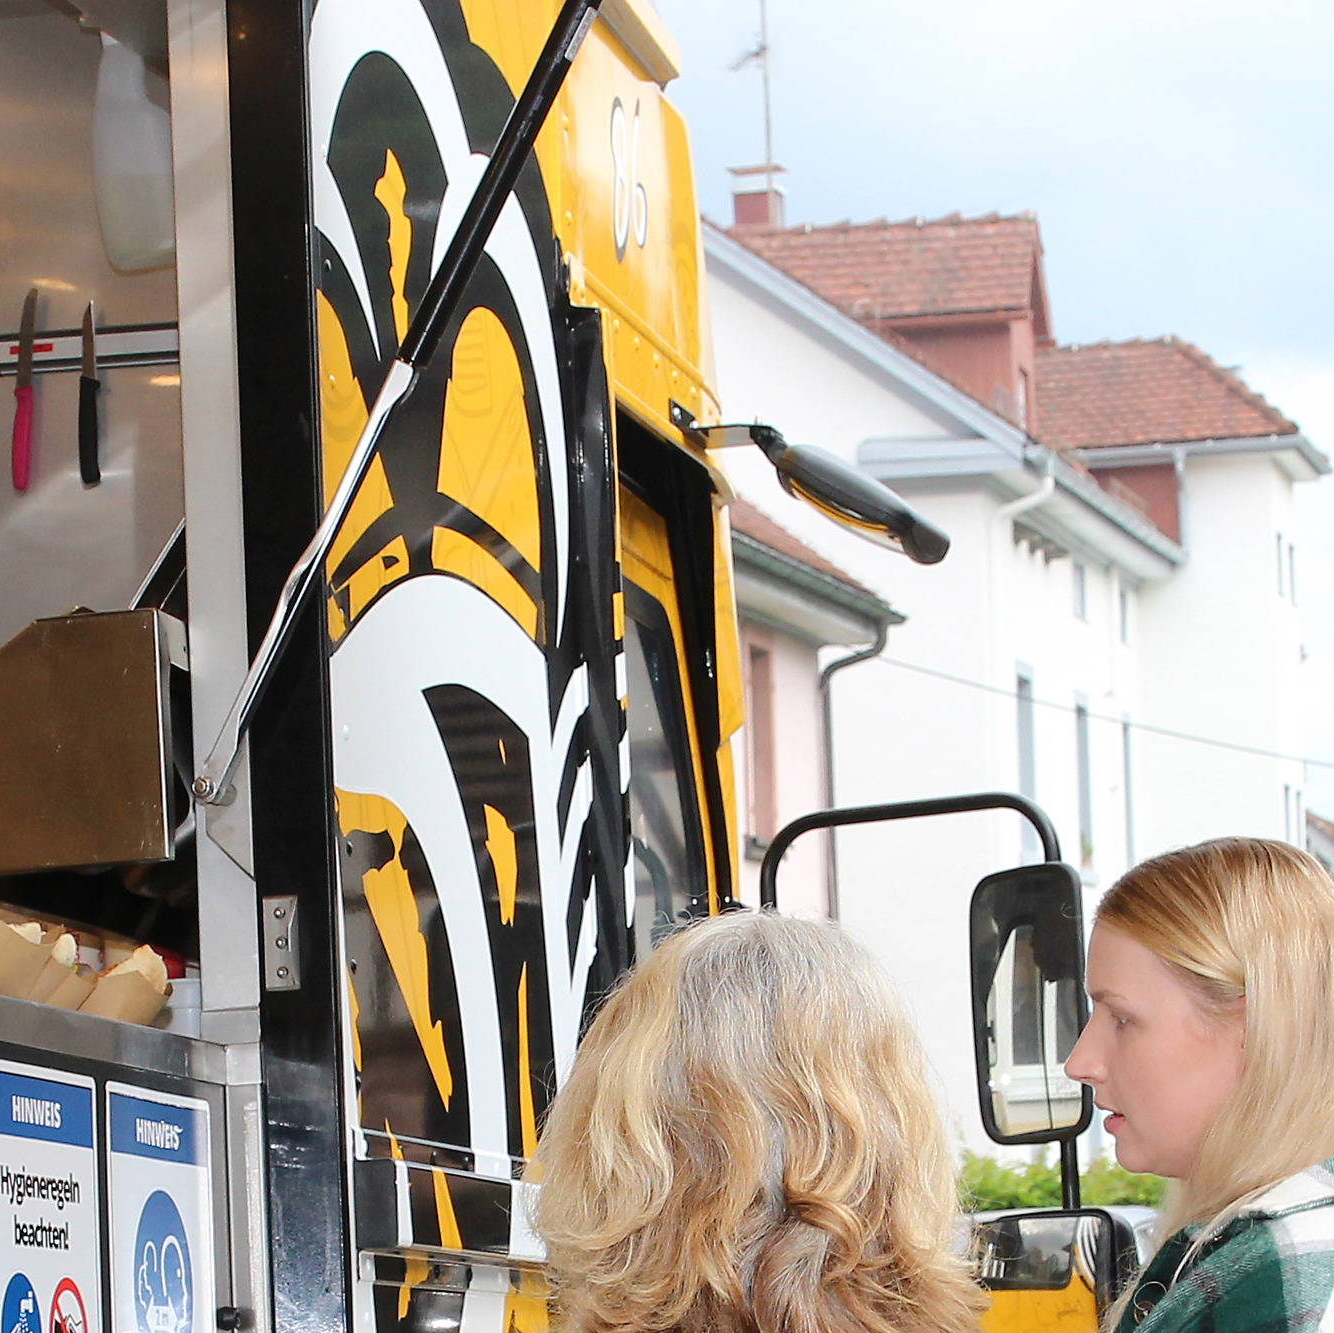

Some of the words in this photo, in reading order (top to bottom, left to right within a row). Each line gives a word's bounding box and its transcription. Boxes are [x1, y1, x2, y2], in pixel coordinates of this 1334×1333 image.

[11, 1094, 61, 1130] HINWEIS
[135, 1117, 182, 1151] HINWEIS
[0, 1165, 81, 1212] Hygieneregeln
[13, 1215, 69, 1251] beachten!
